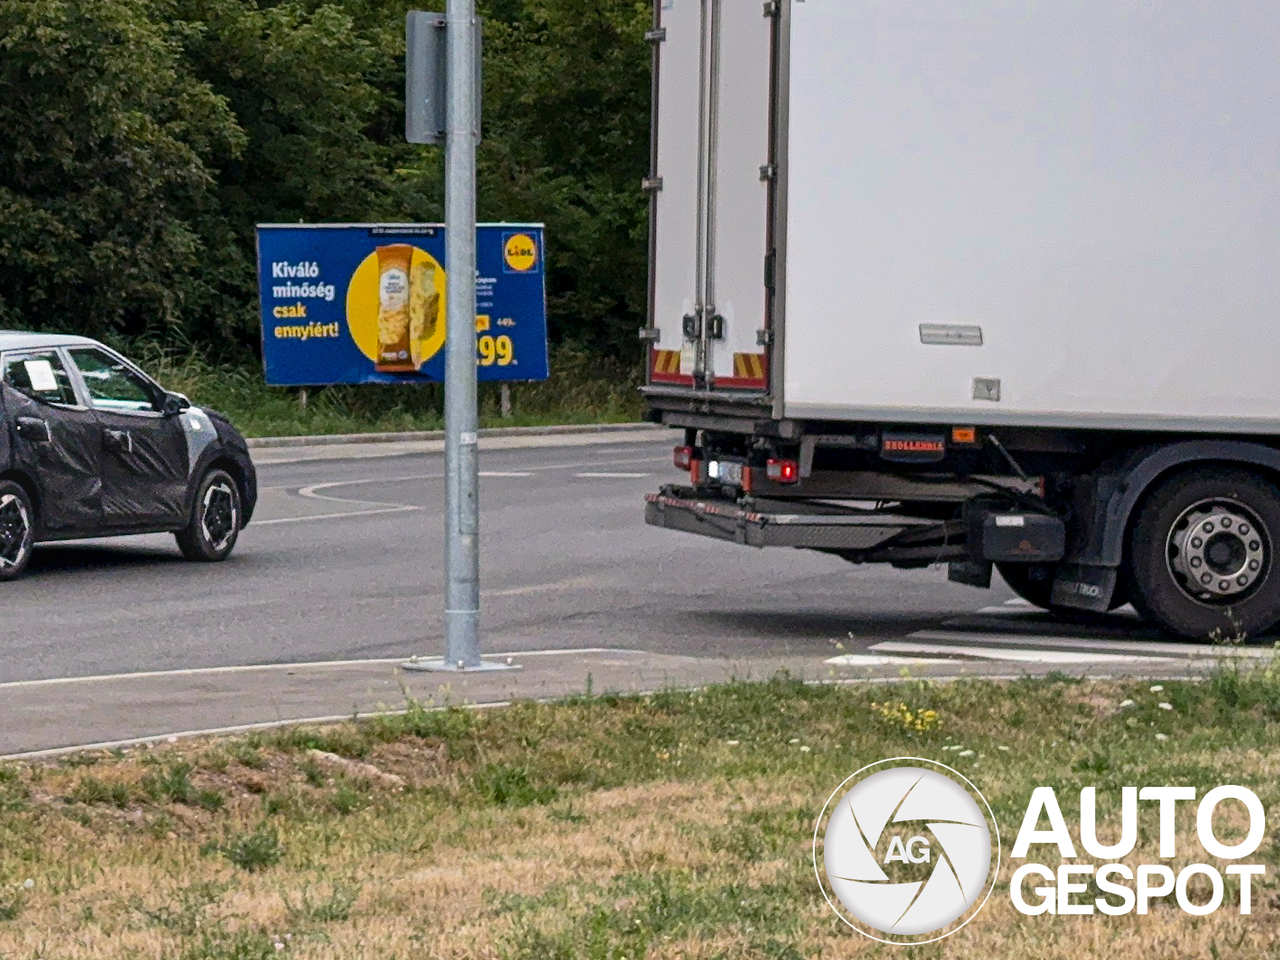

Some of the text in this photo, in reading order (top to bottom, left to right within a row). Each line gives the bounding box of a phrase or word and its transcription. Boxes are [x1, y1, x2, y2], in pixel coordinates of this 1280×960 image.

[272, 261, 320, 278] Kiváló
[272, 281, 336, 302] minőség
[273, 301, 308, 319] csak
[274, 321, 340, 342] ennyiért!
